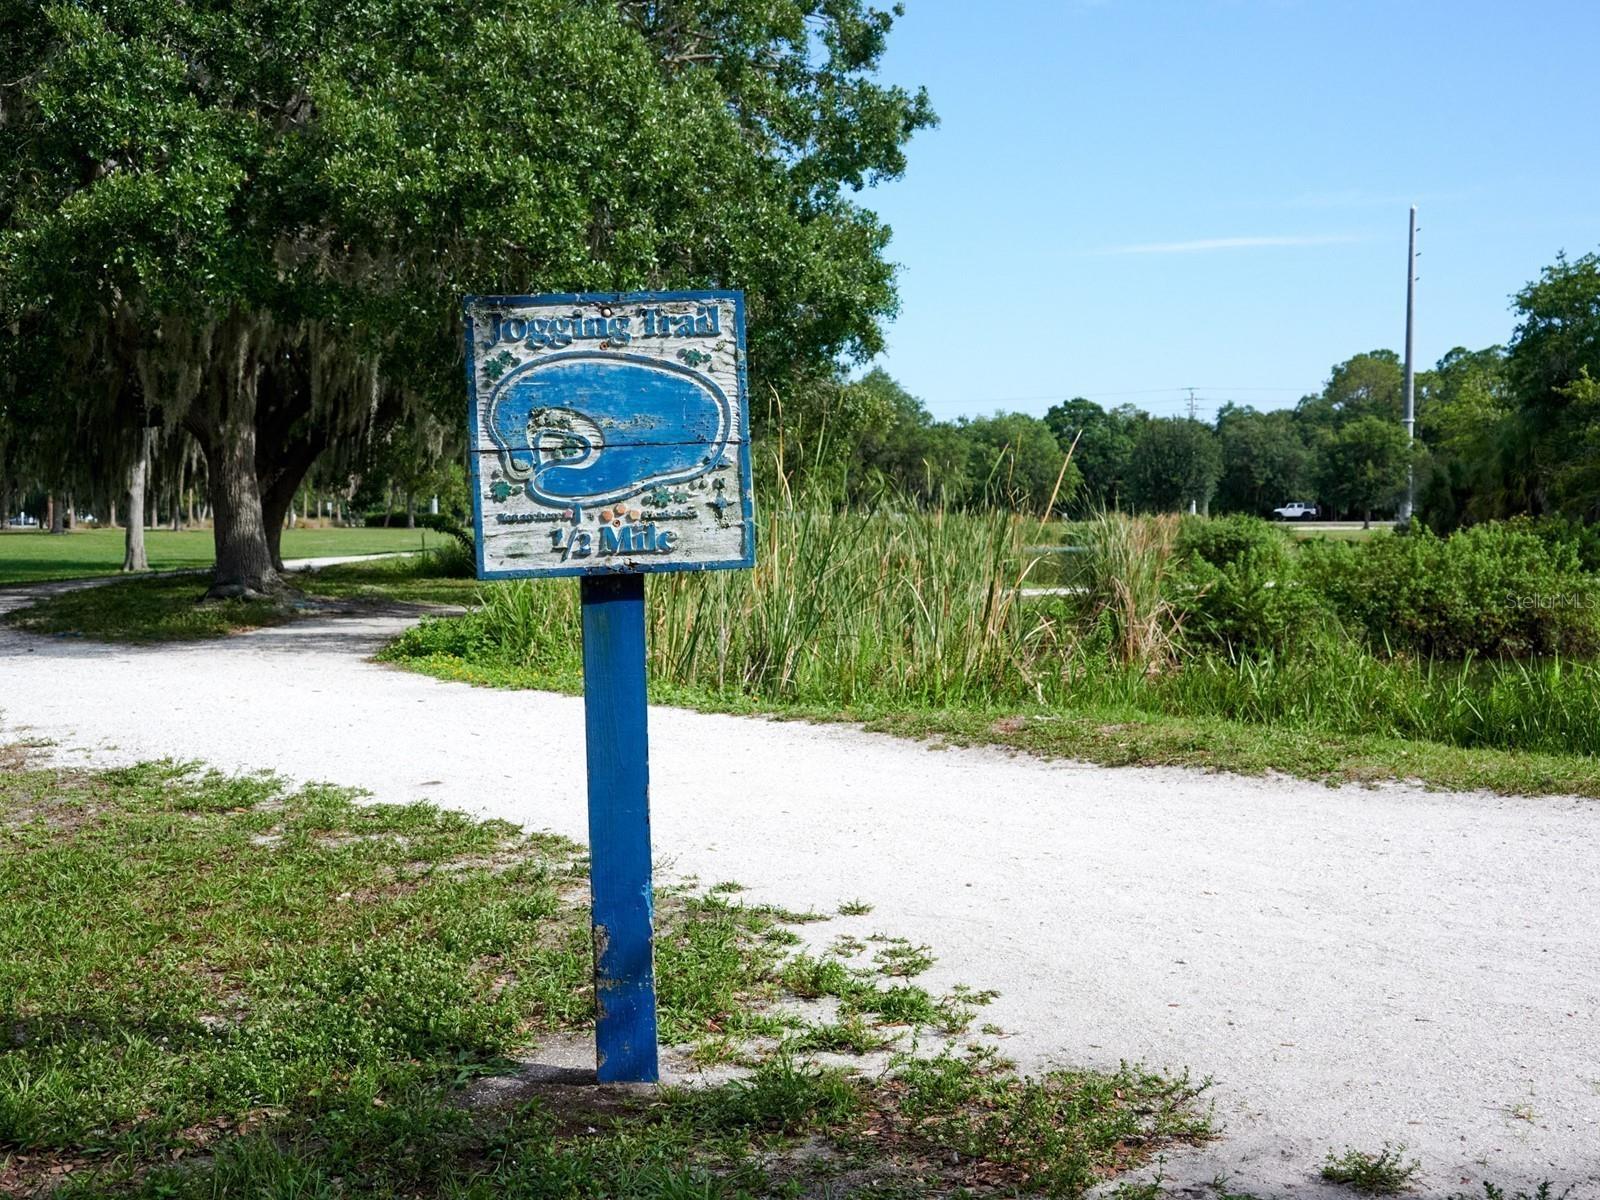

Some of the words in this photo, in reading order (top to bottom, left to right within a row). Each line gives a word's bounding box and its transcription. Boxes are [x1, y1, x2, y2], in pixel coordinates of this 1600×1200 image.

[482, 311, 632, 350] Jogging
[638, 304, 721, 337] Trail
[549, 526, 592, 562] 1/2
[597, 521, 677, 556] Mile
